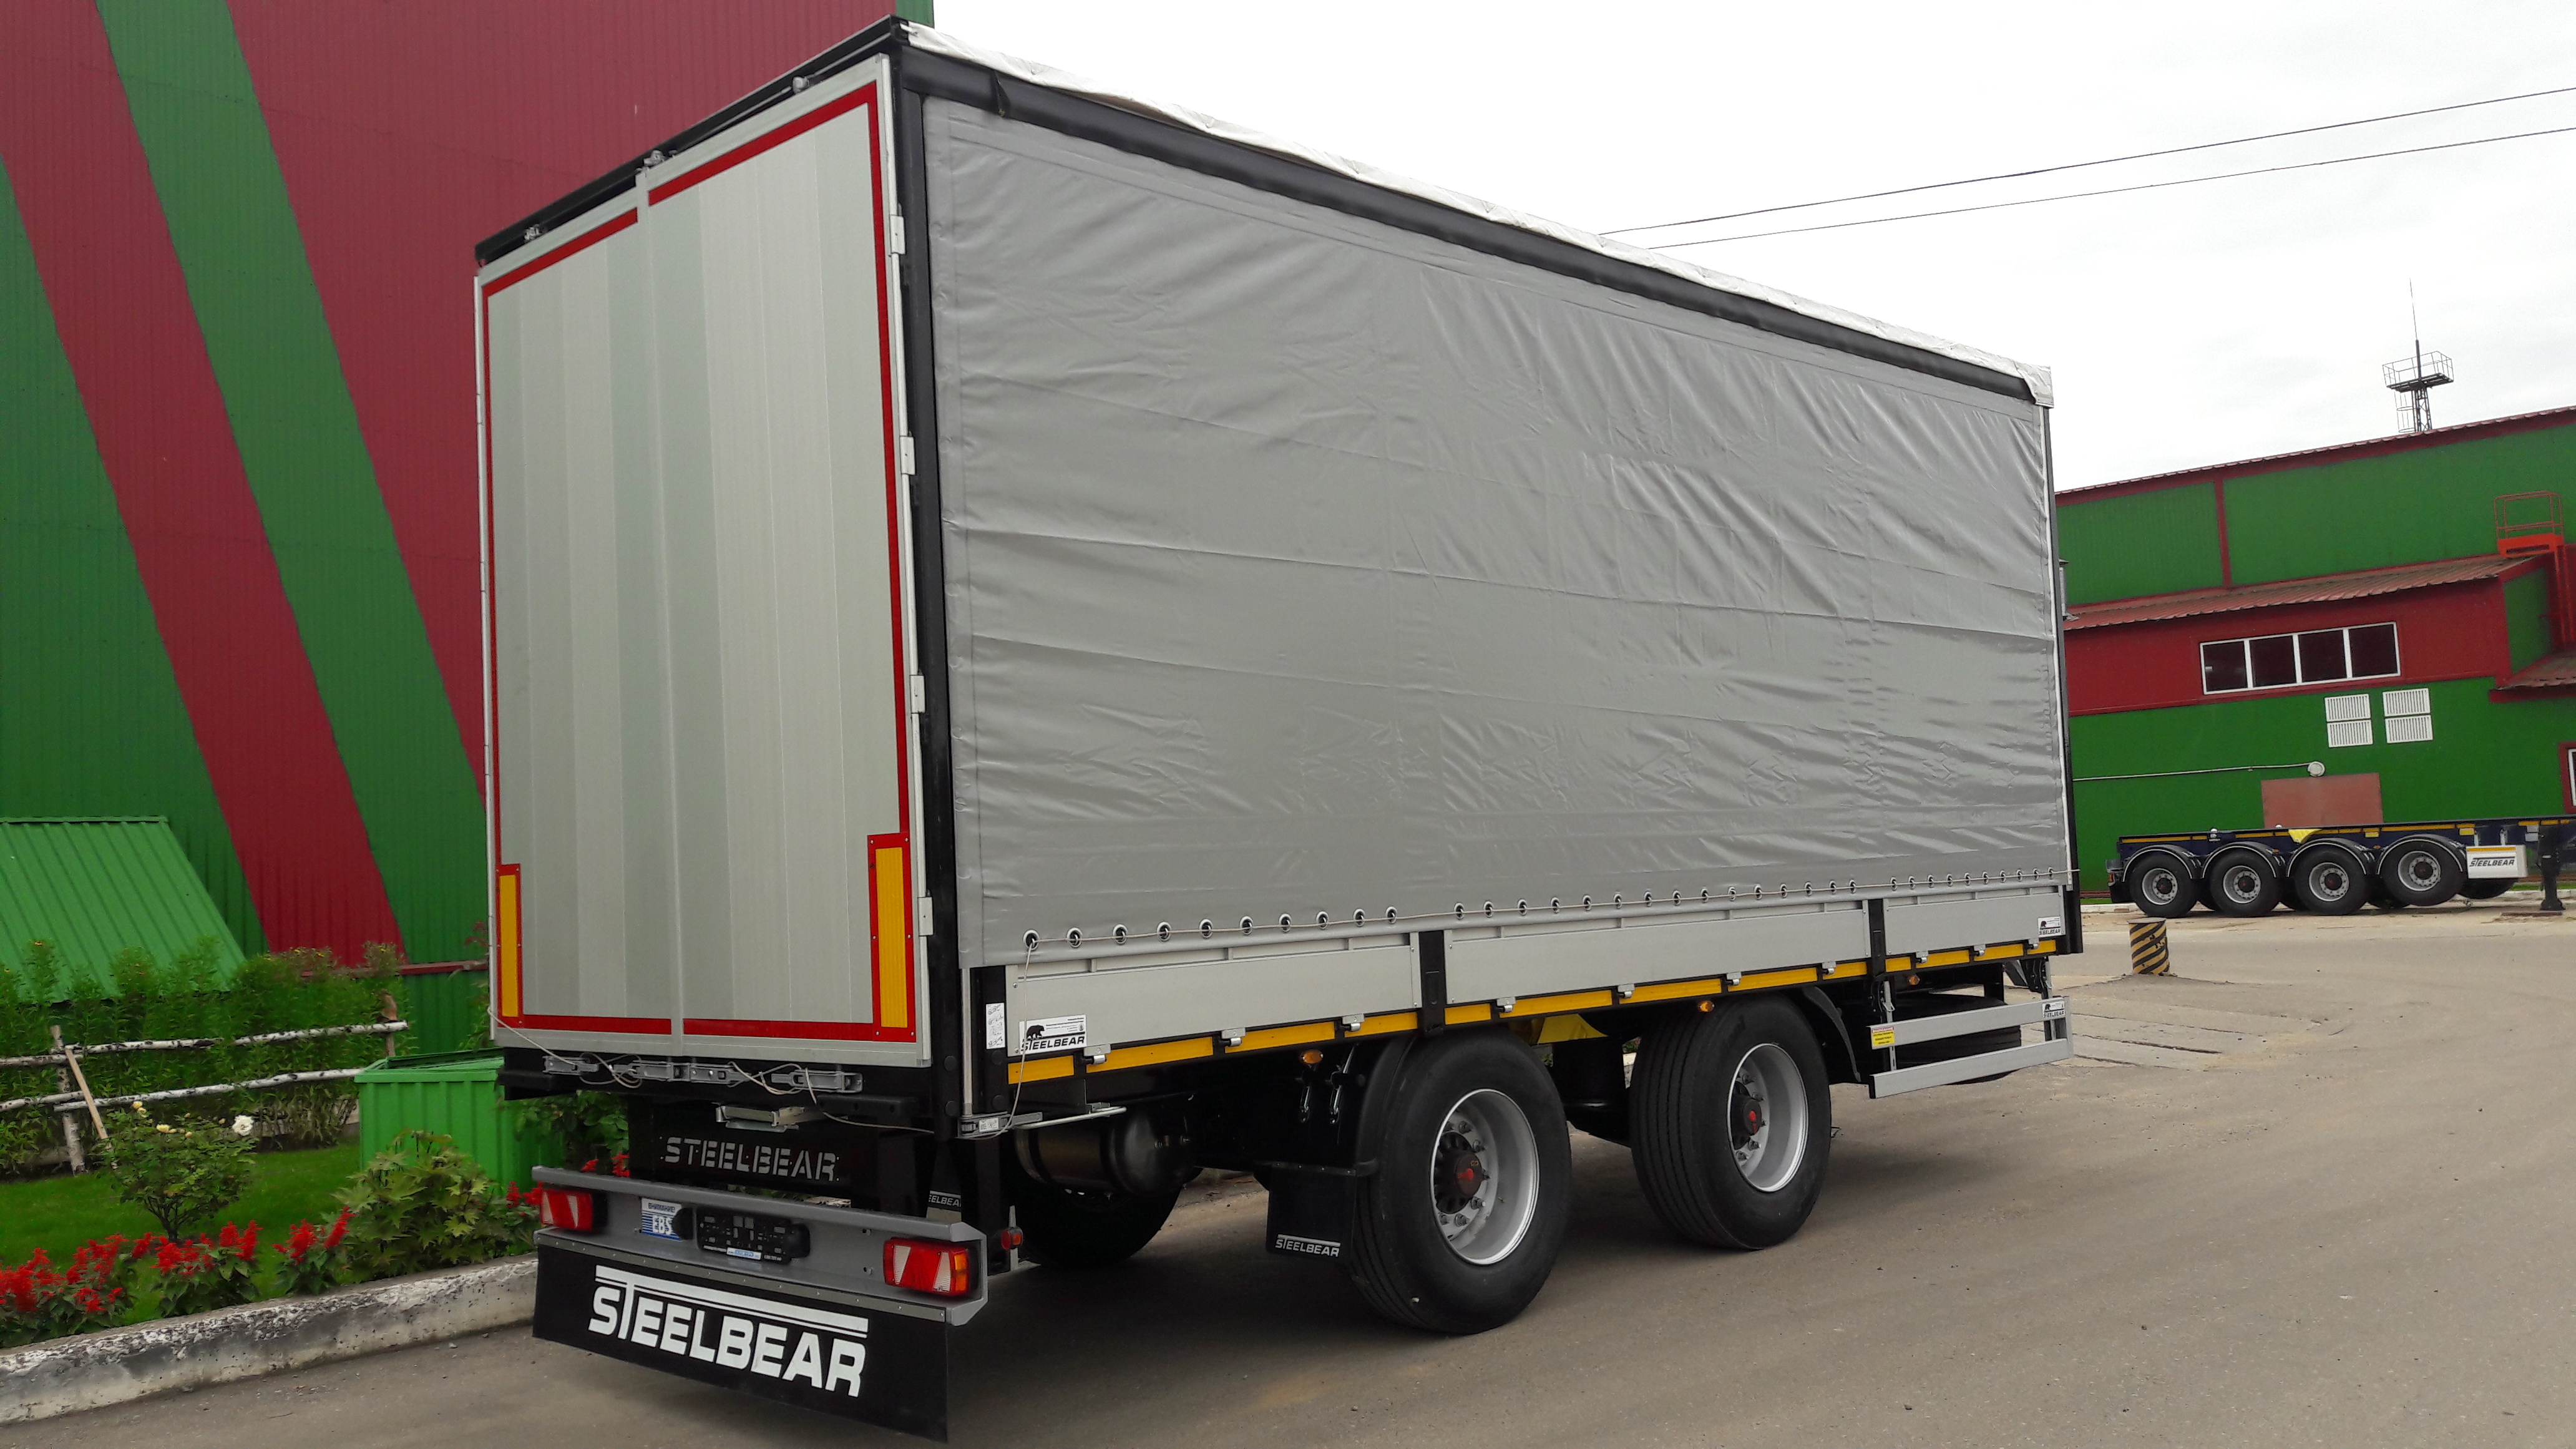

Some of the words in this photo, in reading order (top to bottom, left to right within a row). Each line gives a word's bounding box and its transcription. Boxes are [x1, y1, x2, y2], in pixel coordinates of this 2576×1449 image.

[2469, 856, 2515, 867] STEELBEAR
[1021, 1032, 1086, 1051] STEELBEAR
[665, 1137, 836, 1181] STEELBEAR
[929, 1192, 962, 1207] ELBEA
[652, 1214, 673, 1235] EBS
[1275, 1234, 1341, 1257] STEELBEAR
[588, 1264, 869, 1398] STEELBEAR
